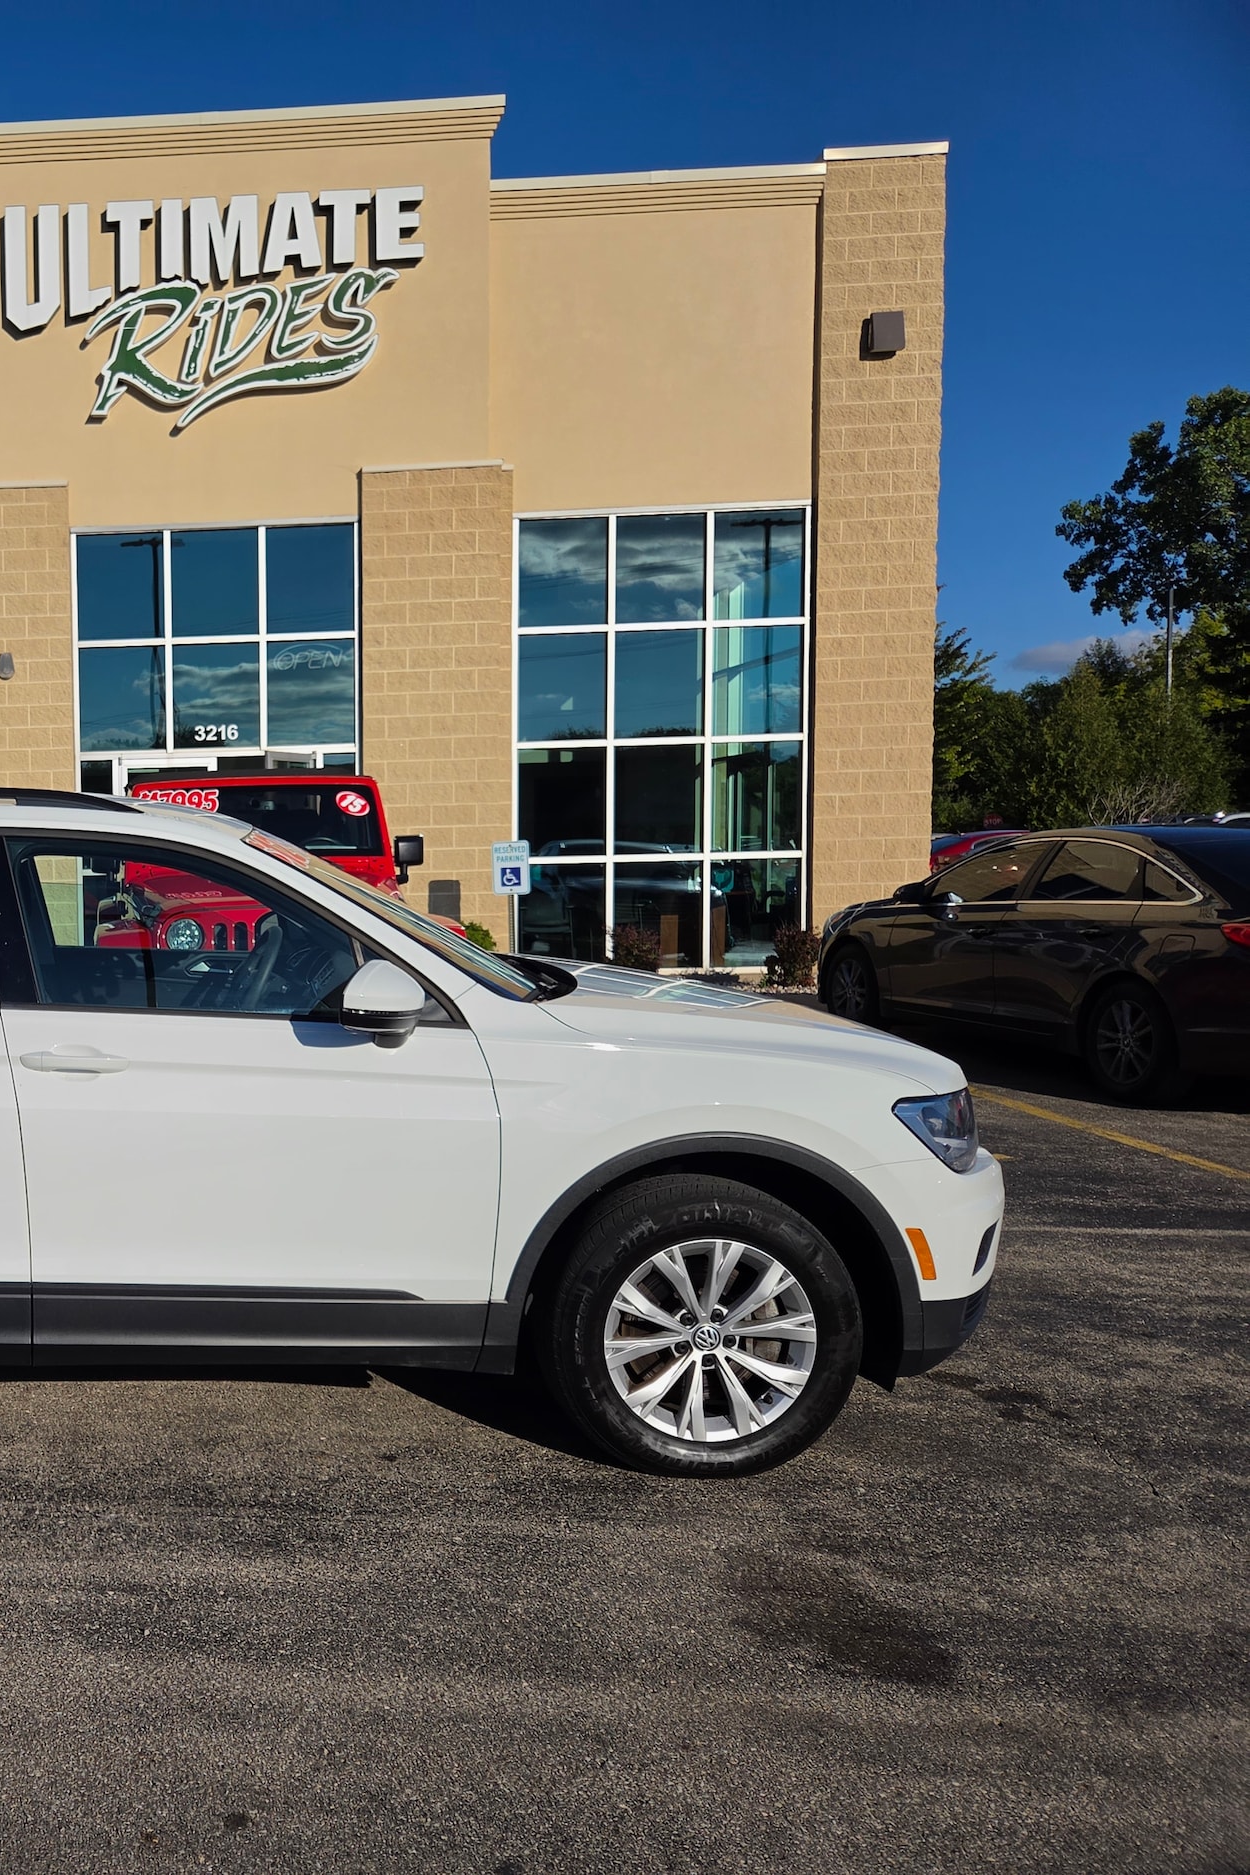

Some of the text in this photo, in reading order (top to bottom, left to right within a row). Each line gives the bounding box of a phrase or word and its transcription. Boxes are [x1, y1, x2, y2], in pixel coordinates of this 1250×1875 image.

[3, 186, 425, 332] ULTIMATE
[275, 650, 344, 671] OPEN
[194, 724, 239, 741] 3216
[983, 818, 1004, 827] STOP
[494, 845, 526, 854] RESERVED
[496, 855, 525, 863] PARKING
[694, 1326, 720, 1351] VW
